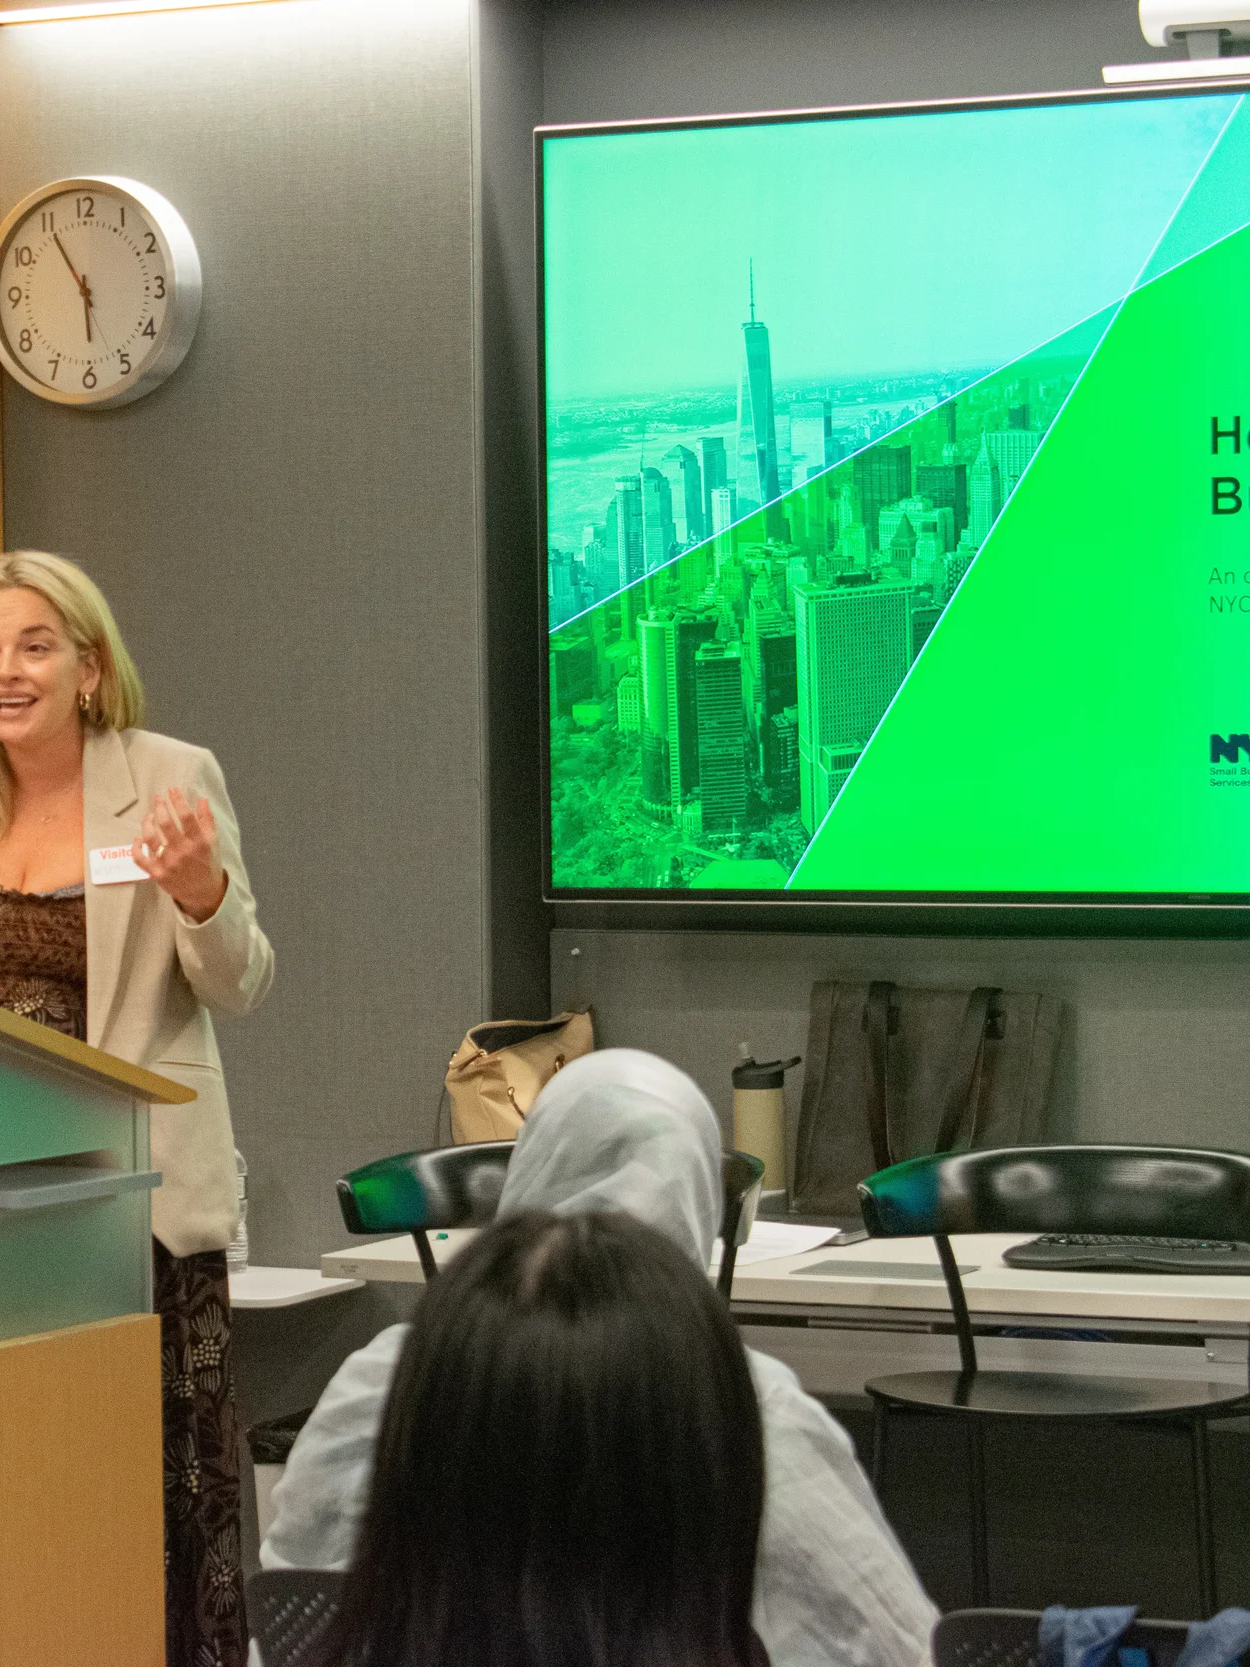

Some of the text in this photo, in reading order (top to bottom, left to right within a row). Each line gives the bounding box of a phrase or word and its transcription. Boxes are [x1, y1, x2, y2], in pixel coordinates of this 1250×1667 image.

[76, 197, 95, 218] 12
[119, 207, 126, 228] 1
[41, 212, 55, 233] 11
[144, 232, 157, 254] 2
[14, 246, 33, 268] 10
[8, 286, 23, 310] 9
[153, 276, 166, 300] 3
[141, 316, 157, 341] 4
[19, 329, 33, 353] 8
[47, 359, 60, 381] 7
[119, 353, 132, 376] 5
[82, 366, 97, 389] 6
[1208, 567, 1235, 585] An
[1209, 767, 1237, 776] Small
[100, 848, 134, 860] Visito
